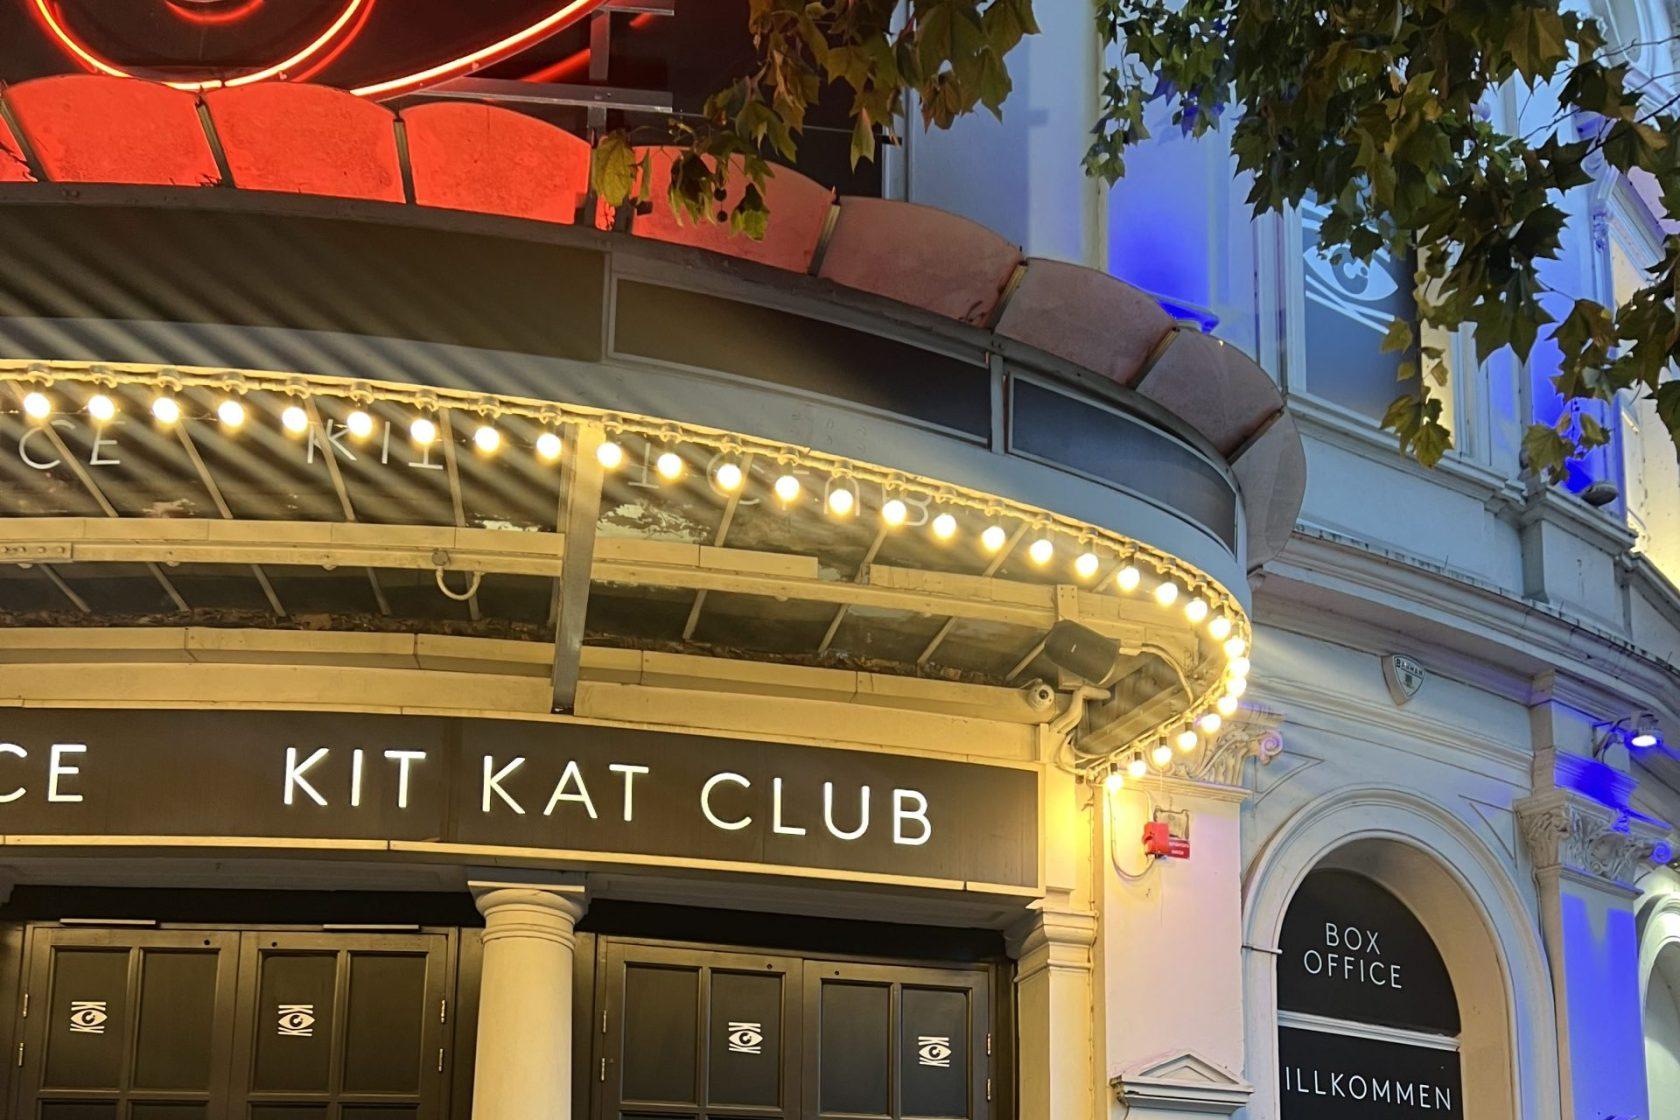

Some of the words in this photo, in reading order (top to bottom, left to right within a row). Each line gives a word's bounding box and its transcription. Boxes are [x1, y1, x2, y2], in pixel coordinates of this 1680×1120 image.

[283, 746, 426, 808] KIT
[481, 755, 650, 822] KAT
[700, 772, 932, 846] CLUB
[1325, 922, 1381, 955] BOX
[1303, 949, 1403, 989] OFFICE
